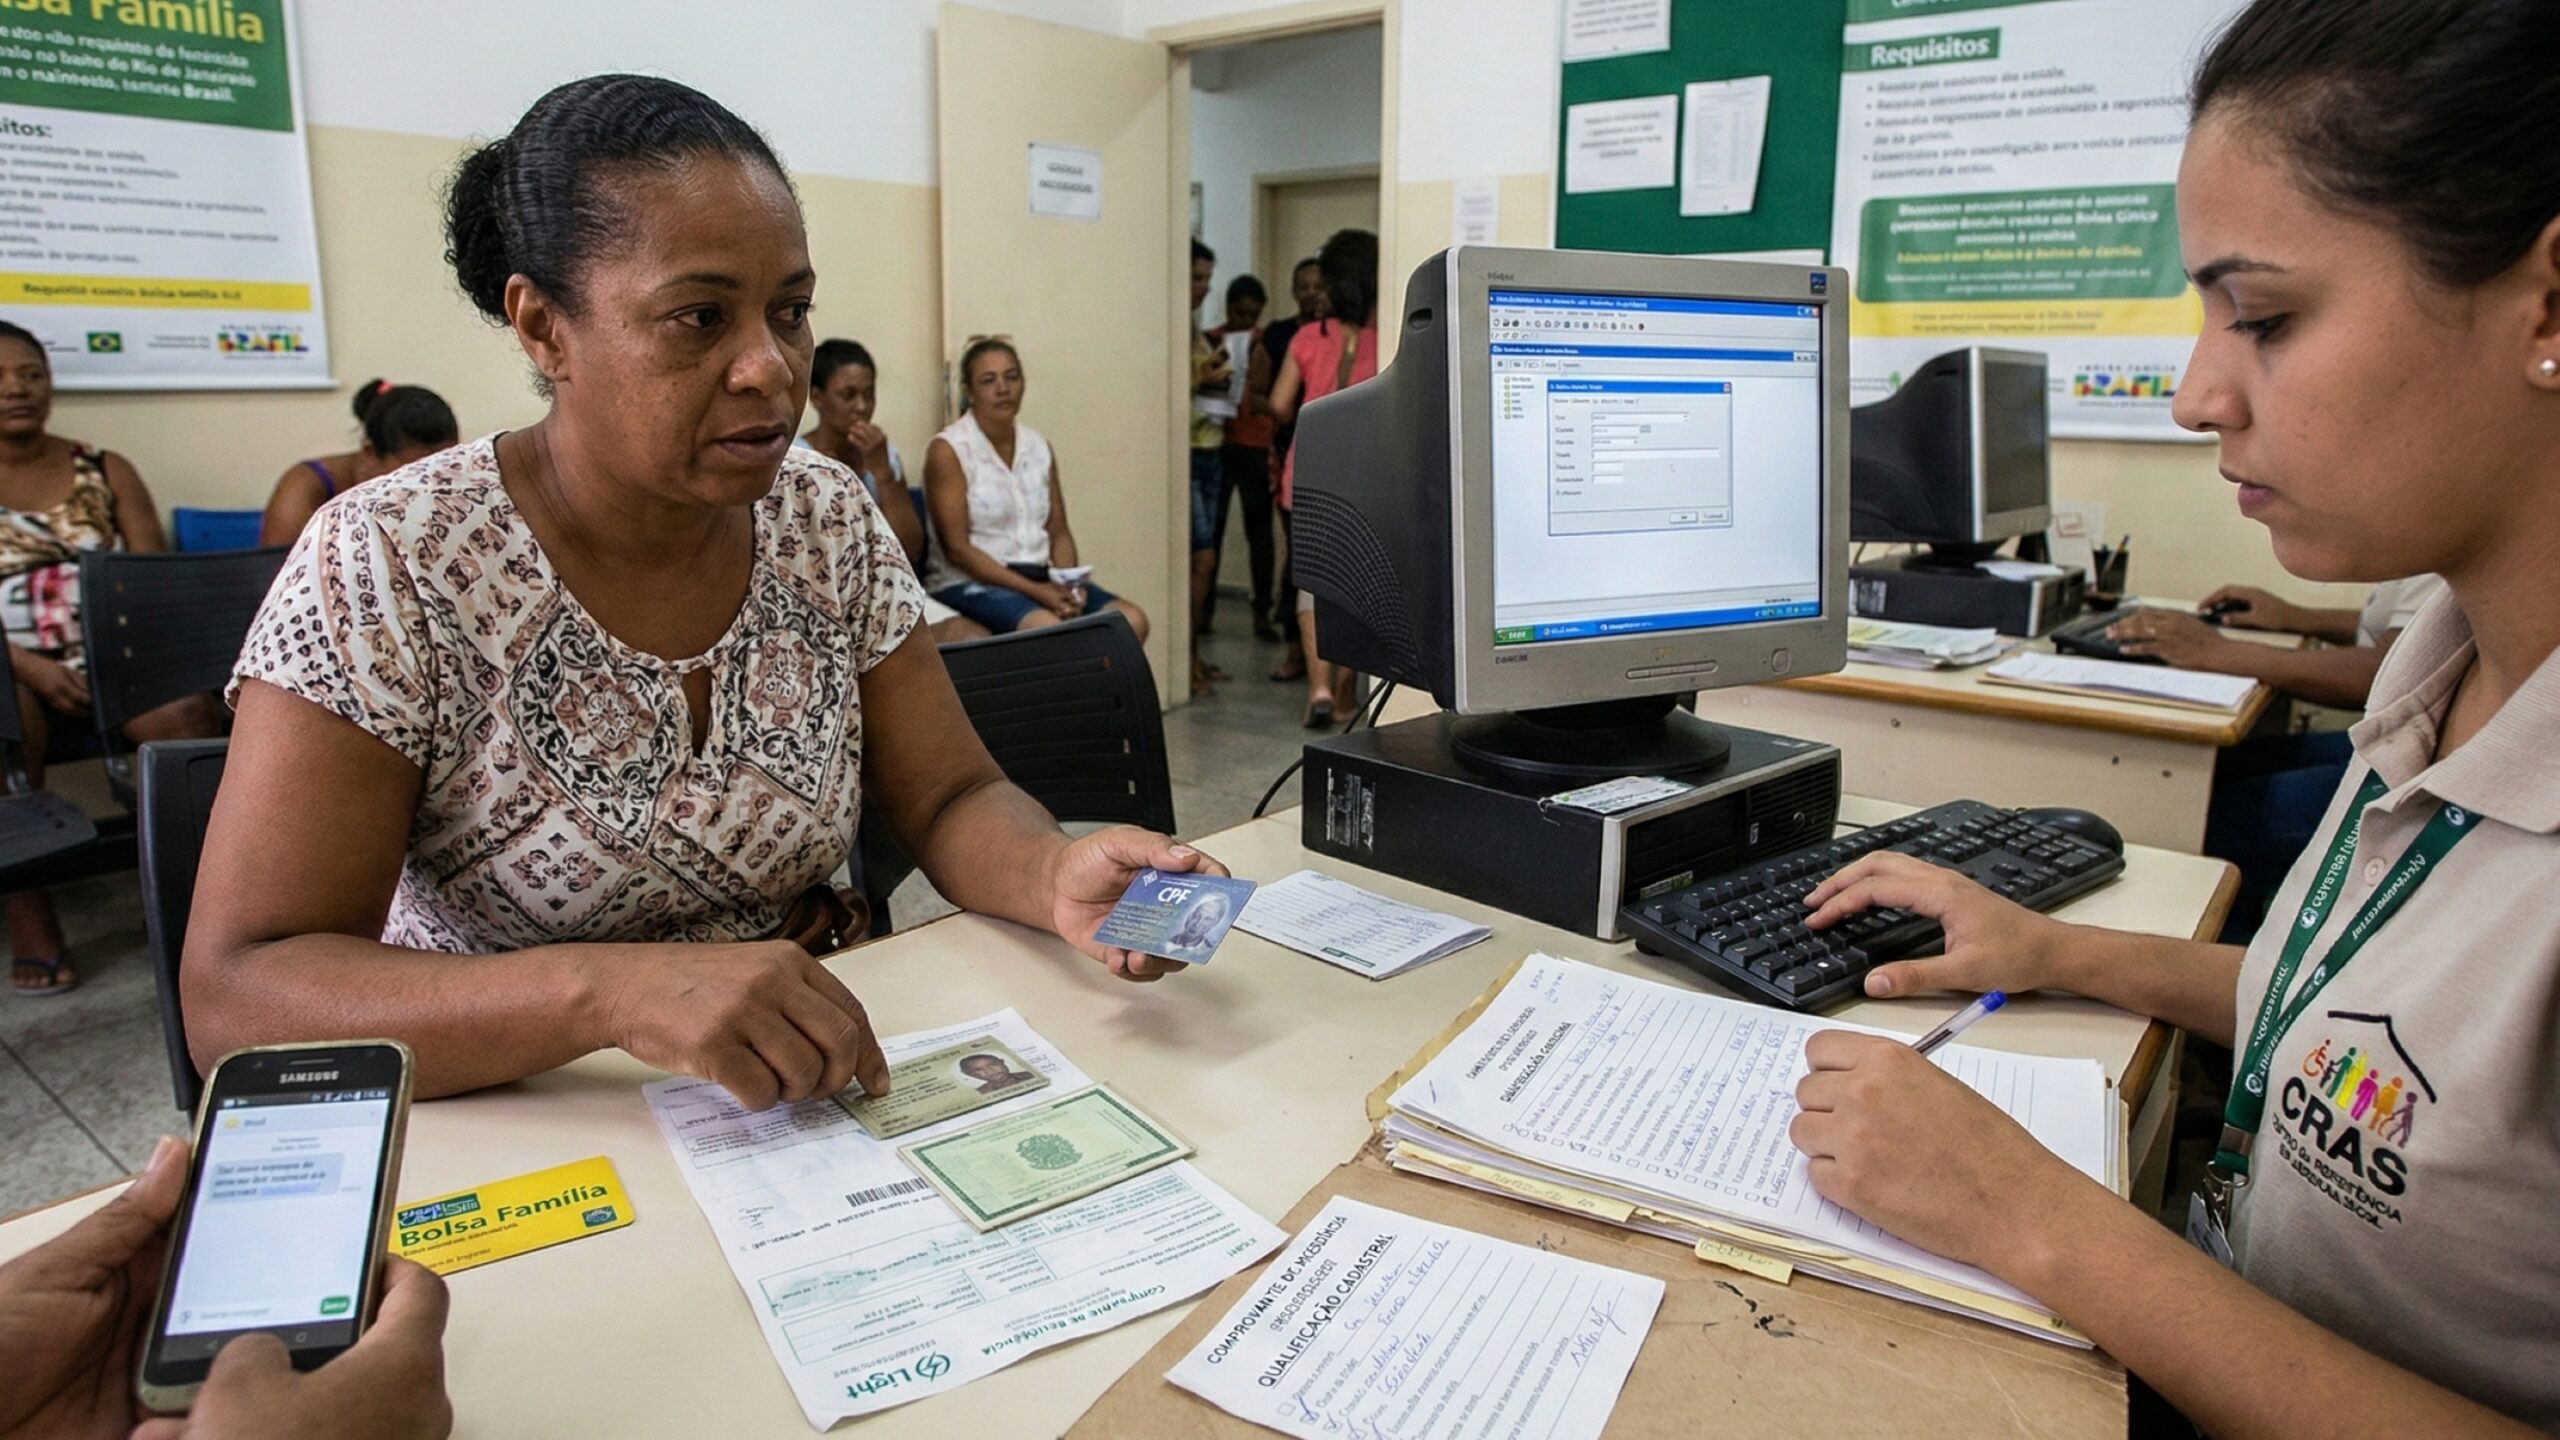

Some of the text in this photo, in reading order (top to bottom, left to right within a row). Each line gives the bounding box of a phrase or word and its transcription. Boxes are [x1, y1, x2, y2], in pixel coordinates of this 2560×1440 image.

[90, 0, 264, 43] Família
[1871, 37, 1990, 66] Requisitos
[1157, 887, 1192, 905] CPF
[2281, 1076, 2408, 1196] CRAS
[400, 1215, 488, 1248] Bolsa
[497, 1184, 609, 1222] Família
[847, 1369, 911, 1398] Light
